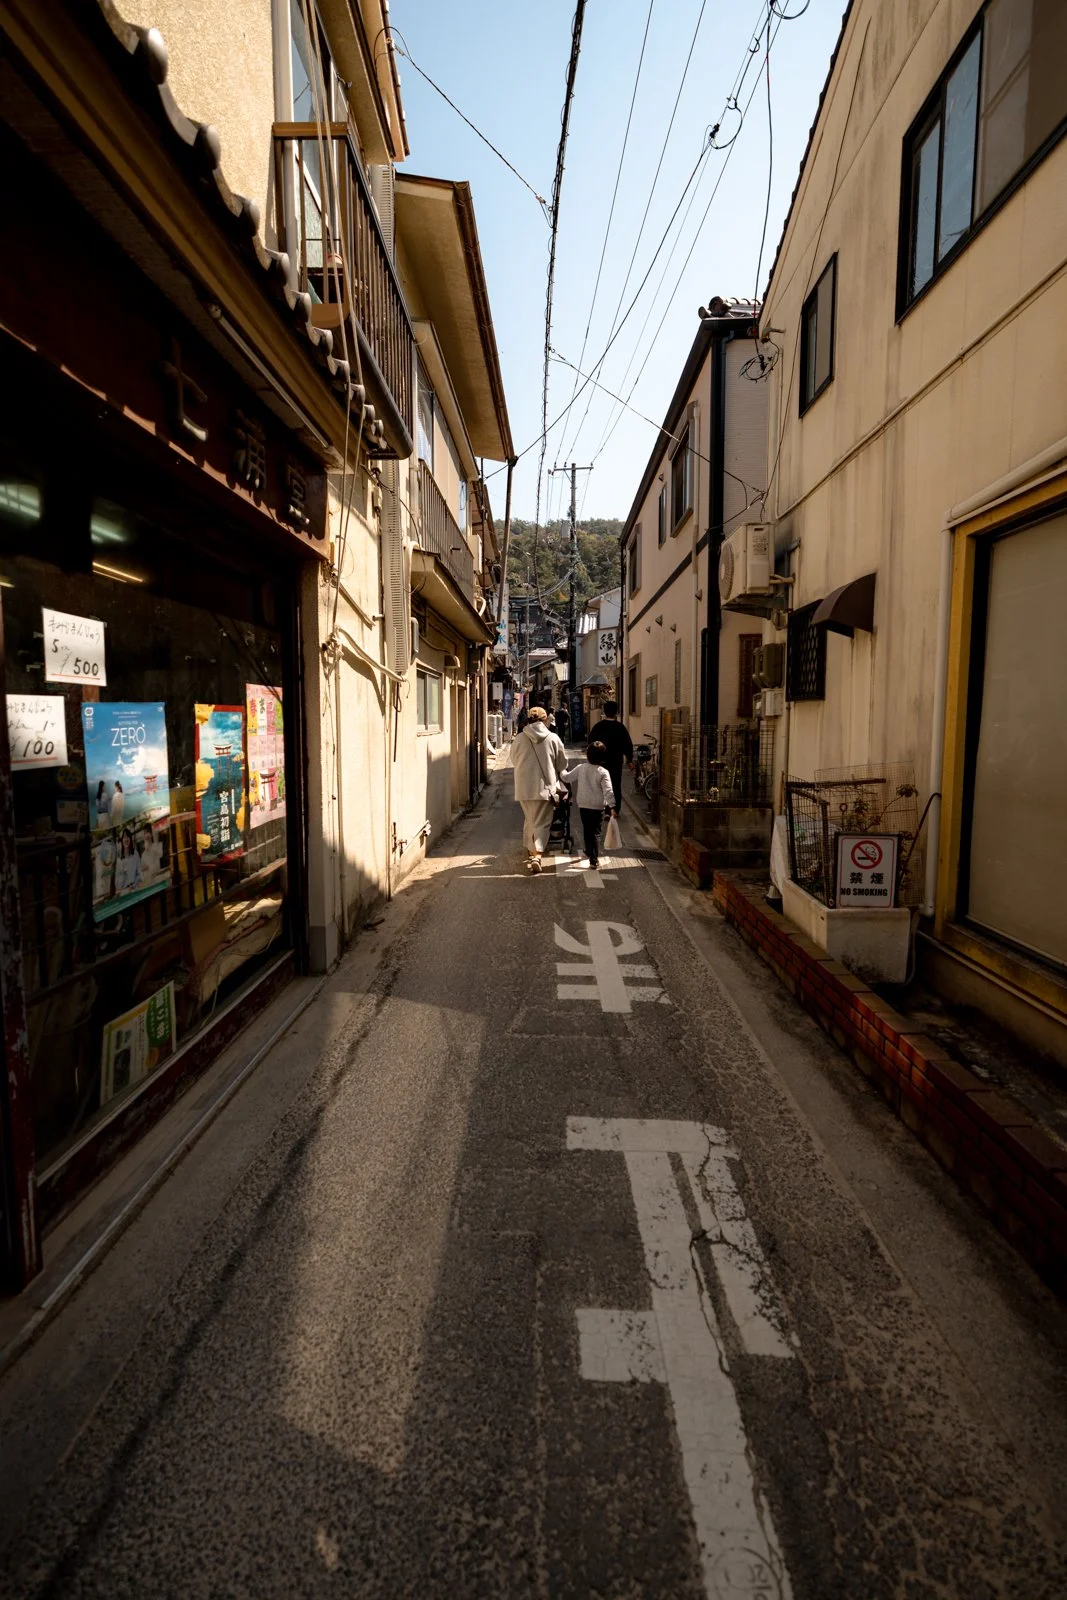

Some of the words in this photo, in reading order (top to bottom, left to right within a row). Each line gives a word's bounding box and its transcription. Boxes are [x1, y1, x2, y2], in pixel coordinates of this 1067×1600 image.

[111, 727, 146, 746] ZERO
[219, 791, 231, 842] 宮島初詣
[850, 872, 884, 884] 禁煙
[840, 887, 851, 896] NO
[853, 887, 888, 896] SMOKING
